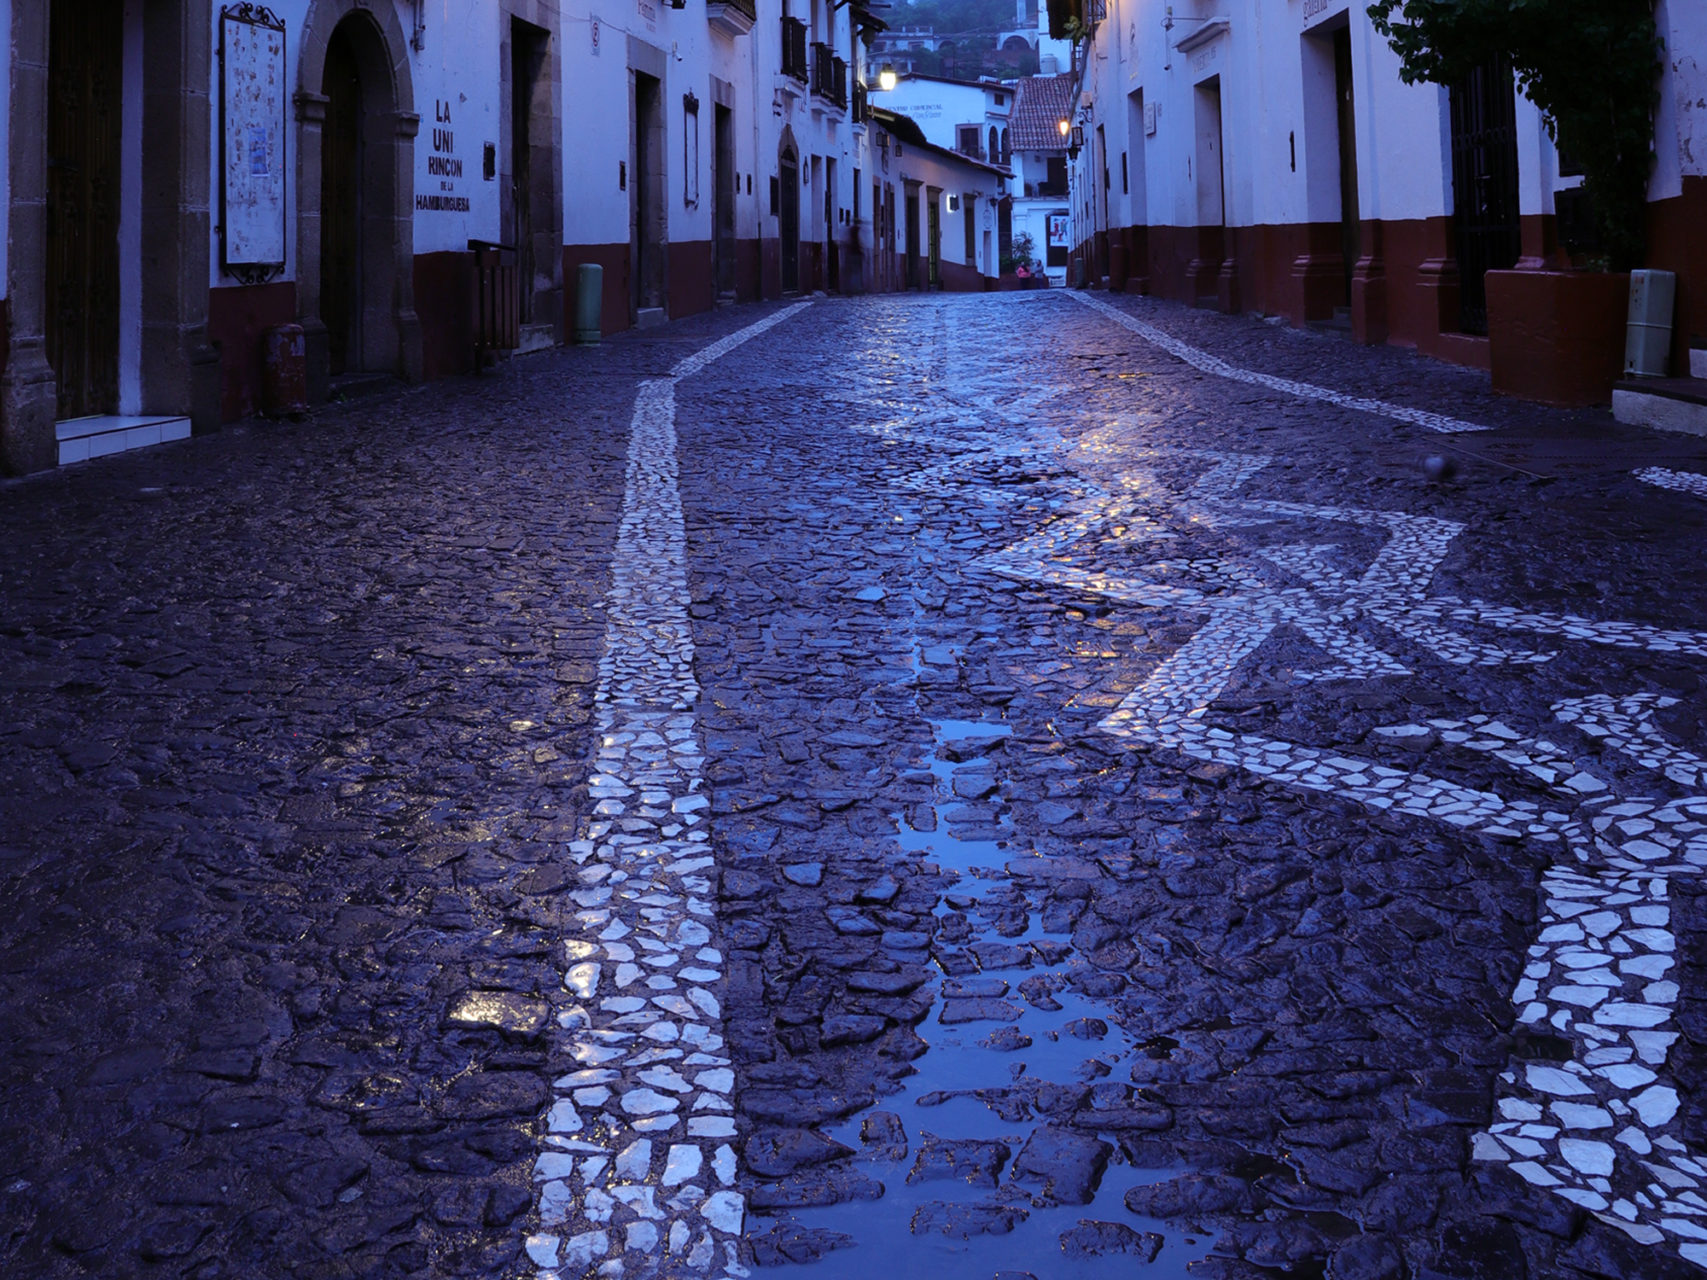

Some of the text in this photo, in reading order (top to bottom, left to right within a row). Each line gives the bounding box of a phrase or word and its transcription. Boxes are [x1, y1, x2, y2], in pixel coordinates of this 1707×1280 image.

[436, 99, 451, 124] LA
[433, 128, 454, 154] UNI
[428, 156, 463, 178] RINCON
[415, 195, 470, 212] HAMBURGUESA
